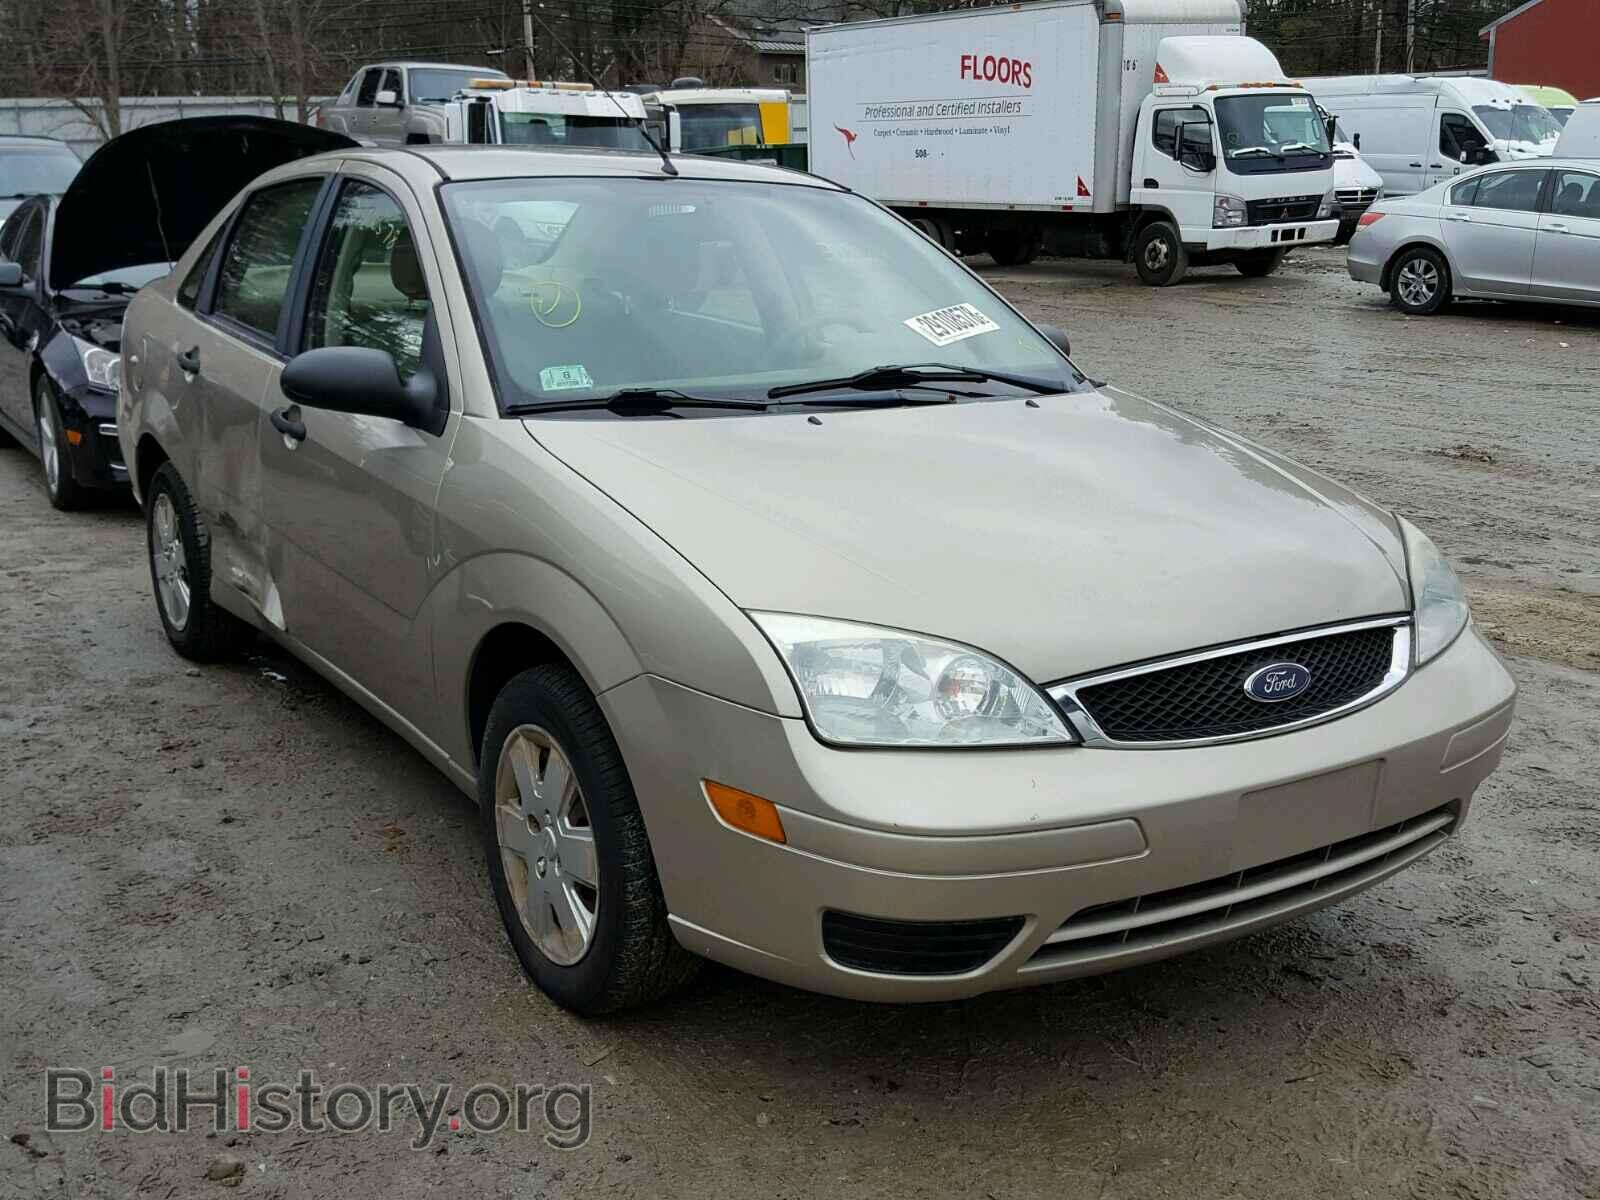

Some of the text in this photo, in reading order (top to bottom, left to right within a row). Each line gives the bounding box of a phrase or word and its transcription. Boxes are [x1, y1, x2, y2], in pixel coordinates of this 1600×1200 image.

[960, 55, 1032, 88] FLOORS
[865, 99, 1022, 119] Professional and Certified Installers
[873, 125, 1010, 138] Carpet Ceramic Hardwood Laminate Vinyl
[1264, 670, 1298, 693] Ford
